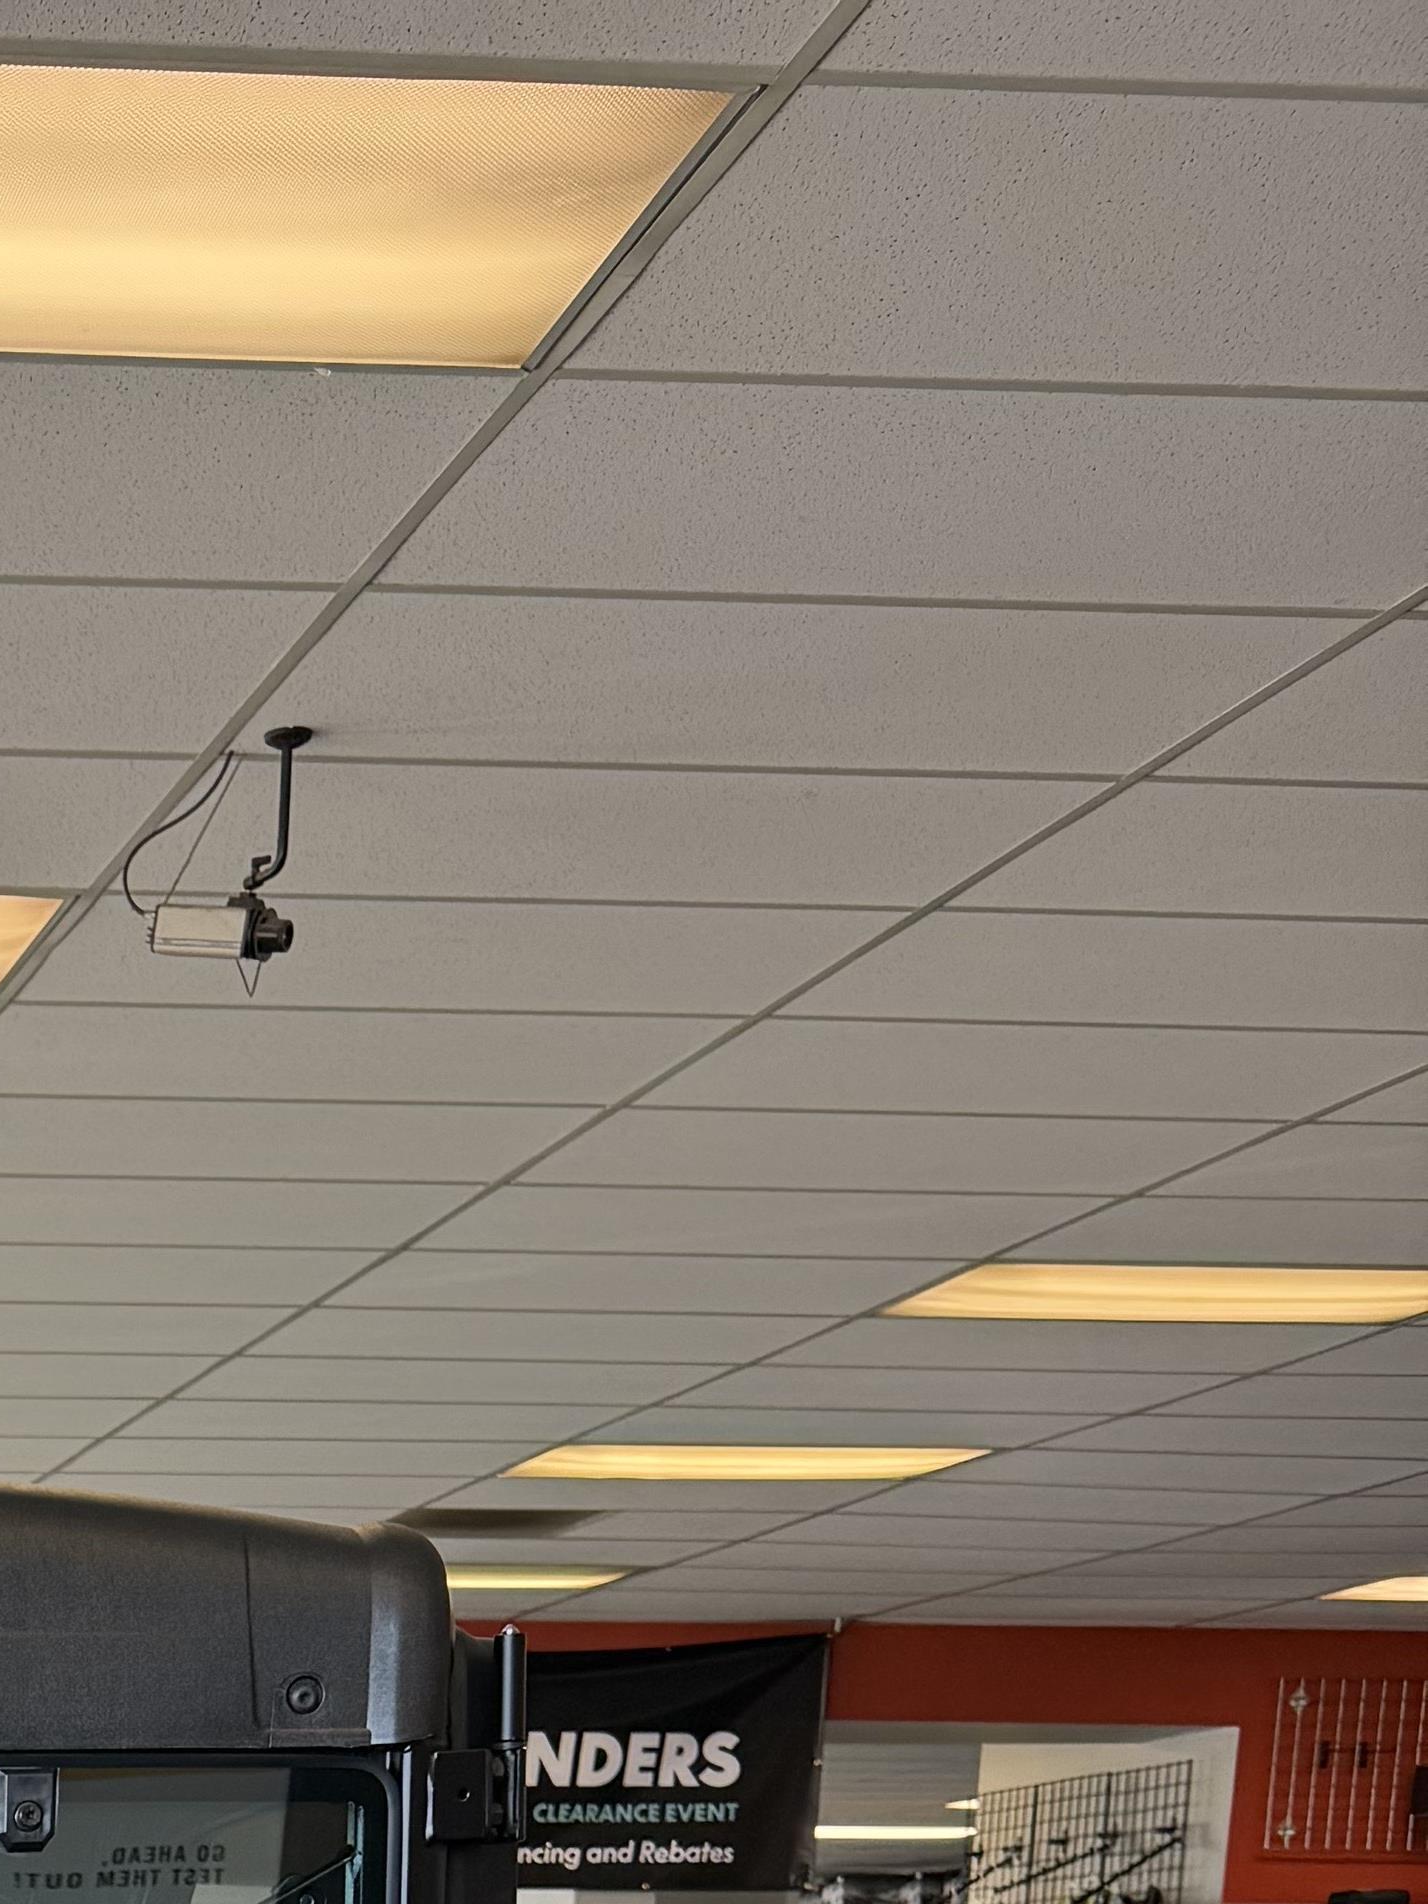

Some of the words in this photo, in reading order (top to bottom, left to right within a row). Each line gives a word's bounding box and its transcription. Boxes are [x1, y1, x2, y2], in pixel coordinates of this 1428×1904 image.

[525, 1730, 742, 1789] NDERS
[533, 1802, 661, 1824] CLEARANCE
[665, 1802, 740, 1823] EVENT
[517, 1841, 582, 1871] ncing
[586, 1839, 635, 1864] and
[639, 1839, 735, 1864] Rebates
